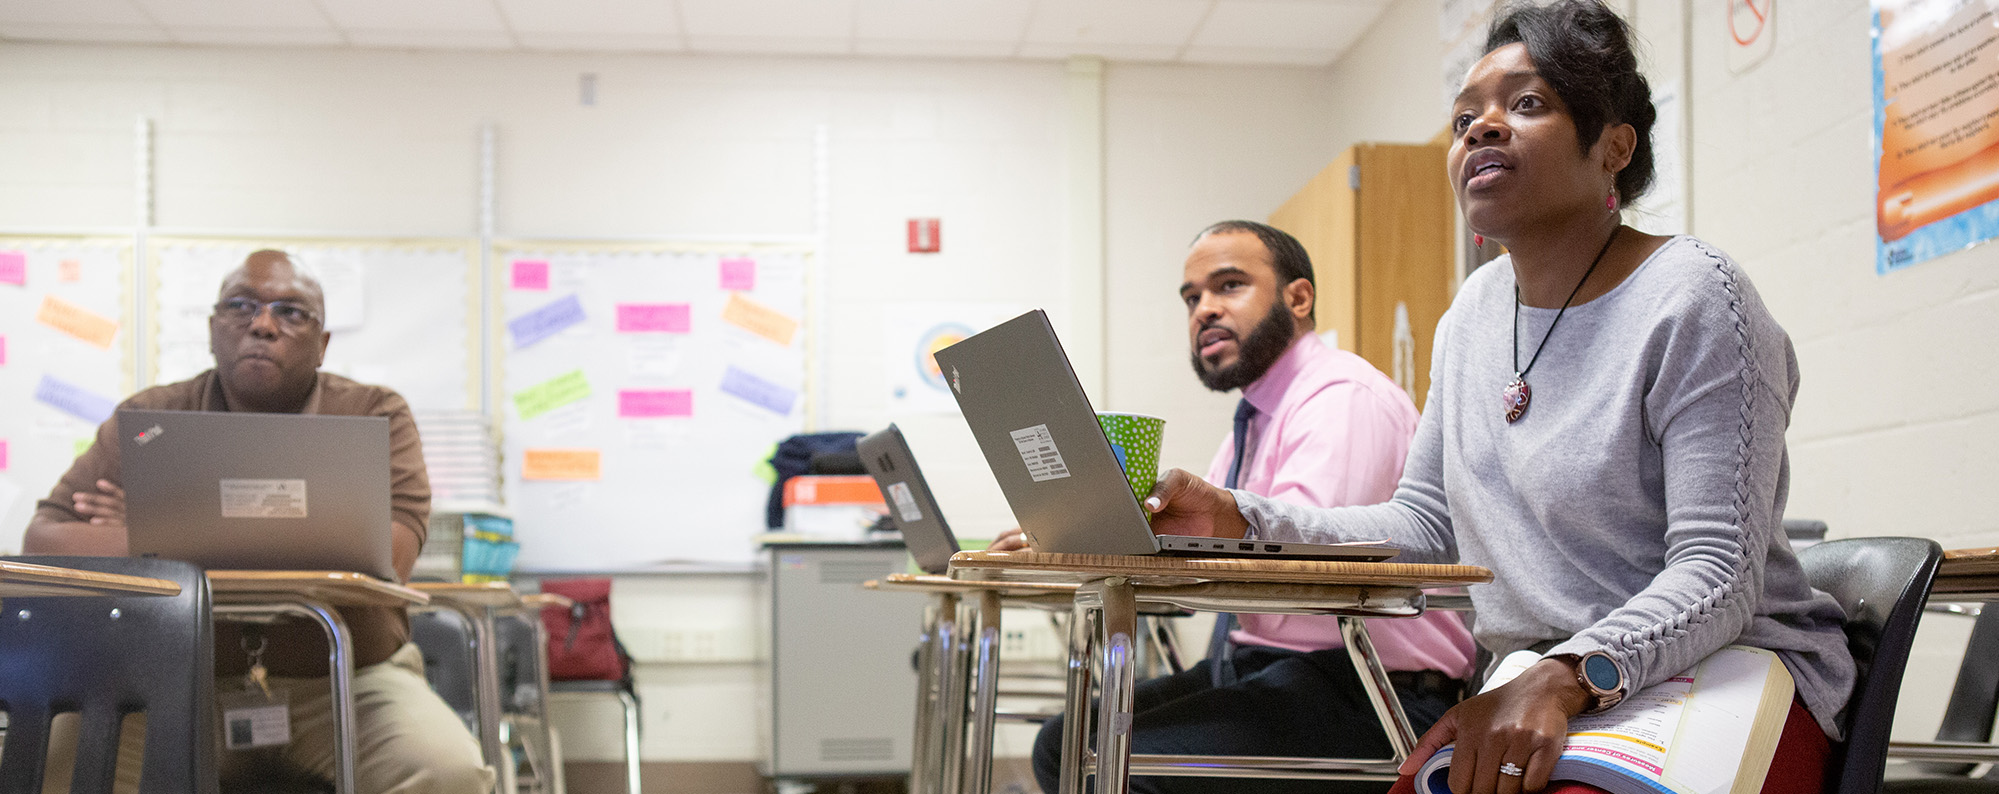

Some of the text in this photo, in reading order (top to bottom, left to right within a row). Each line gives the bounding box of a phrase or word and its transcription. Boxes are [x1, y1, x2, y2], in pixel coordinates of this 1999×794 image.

[1635, 739, 1663, 751] Example
[1586, 747, 1611, 755] Center
[1612, 750, 1621, 758] of
[1622, 754, 1656, 772] Measures
